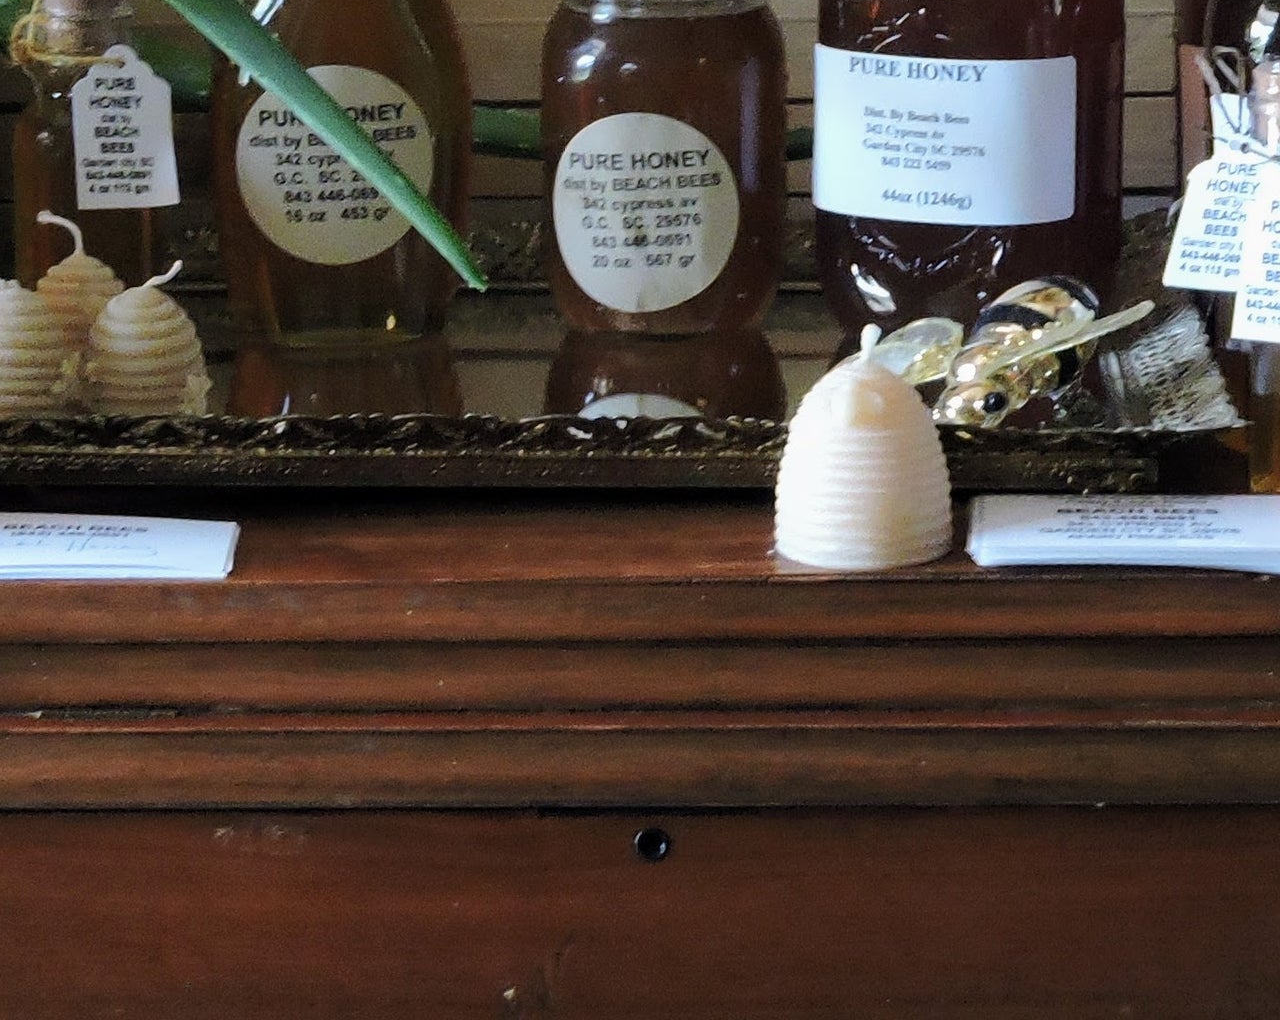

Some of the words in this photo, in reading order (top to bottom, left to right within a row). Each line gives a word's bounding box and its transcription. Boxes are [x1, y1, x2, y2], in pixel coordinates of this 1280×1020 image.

[849, 56, 901, 78] PURE
[907, 61, 988, 83] HONEY
[258, 109, 305, 126] PUR
[345, 102, 406, 122] ONEY
[891, 108, 904, 122] By
[284, 135, 302, 150] by
[570, 153, 623, 171] PURE
[631, 148, 710, 170] HONEY
[1217, 162, 1258, 176] PURE
[591, 179, 606, 193] by
[612, 178, 671, 191] BEACH
[677, 172, 720, 188] BEES
[1206, 180, 1260, 194] HONEY
[882, 189, 912, 203] 44oz
[917, 191, 972, 210] (1246g)
[1203, 209, 1246, 222] BEACH
[1204, 224, 1238, 236] BEES
[614, 258, 631, 268] oz
